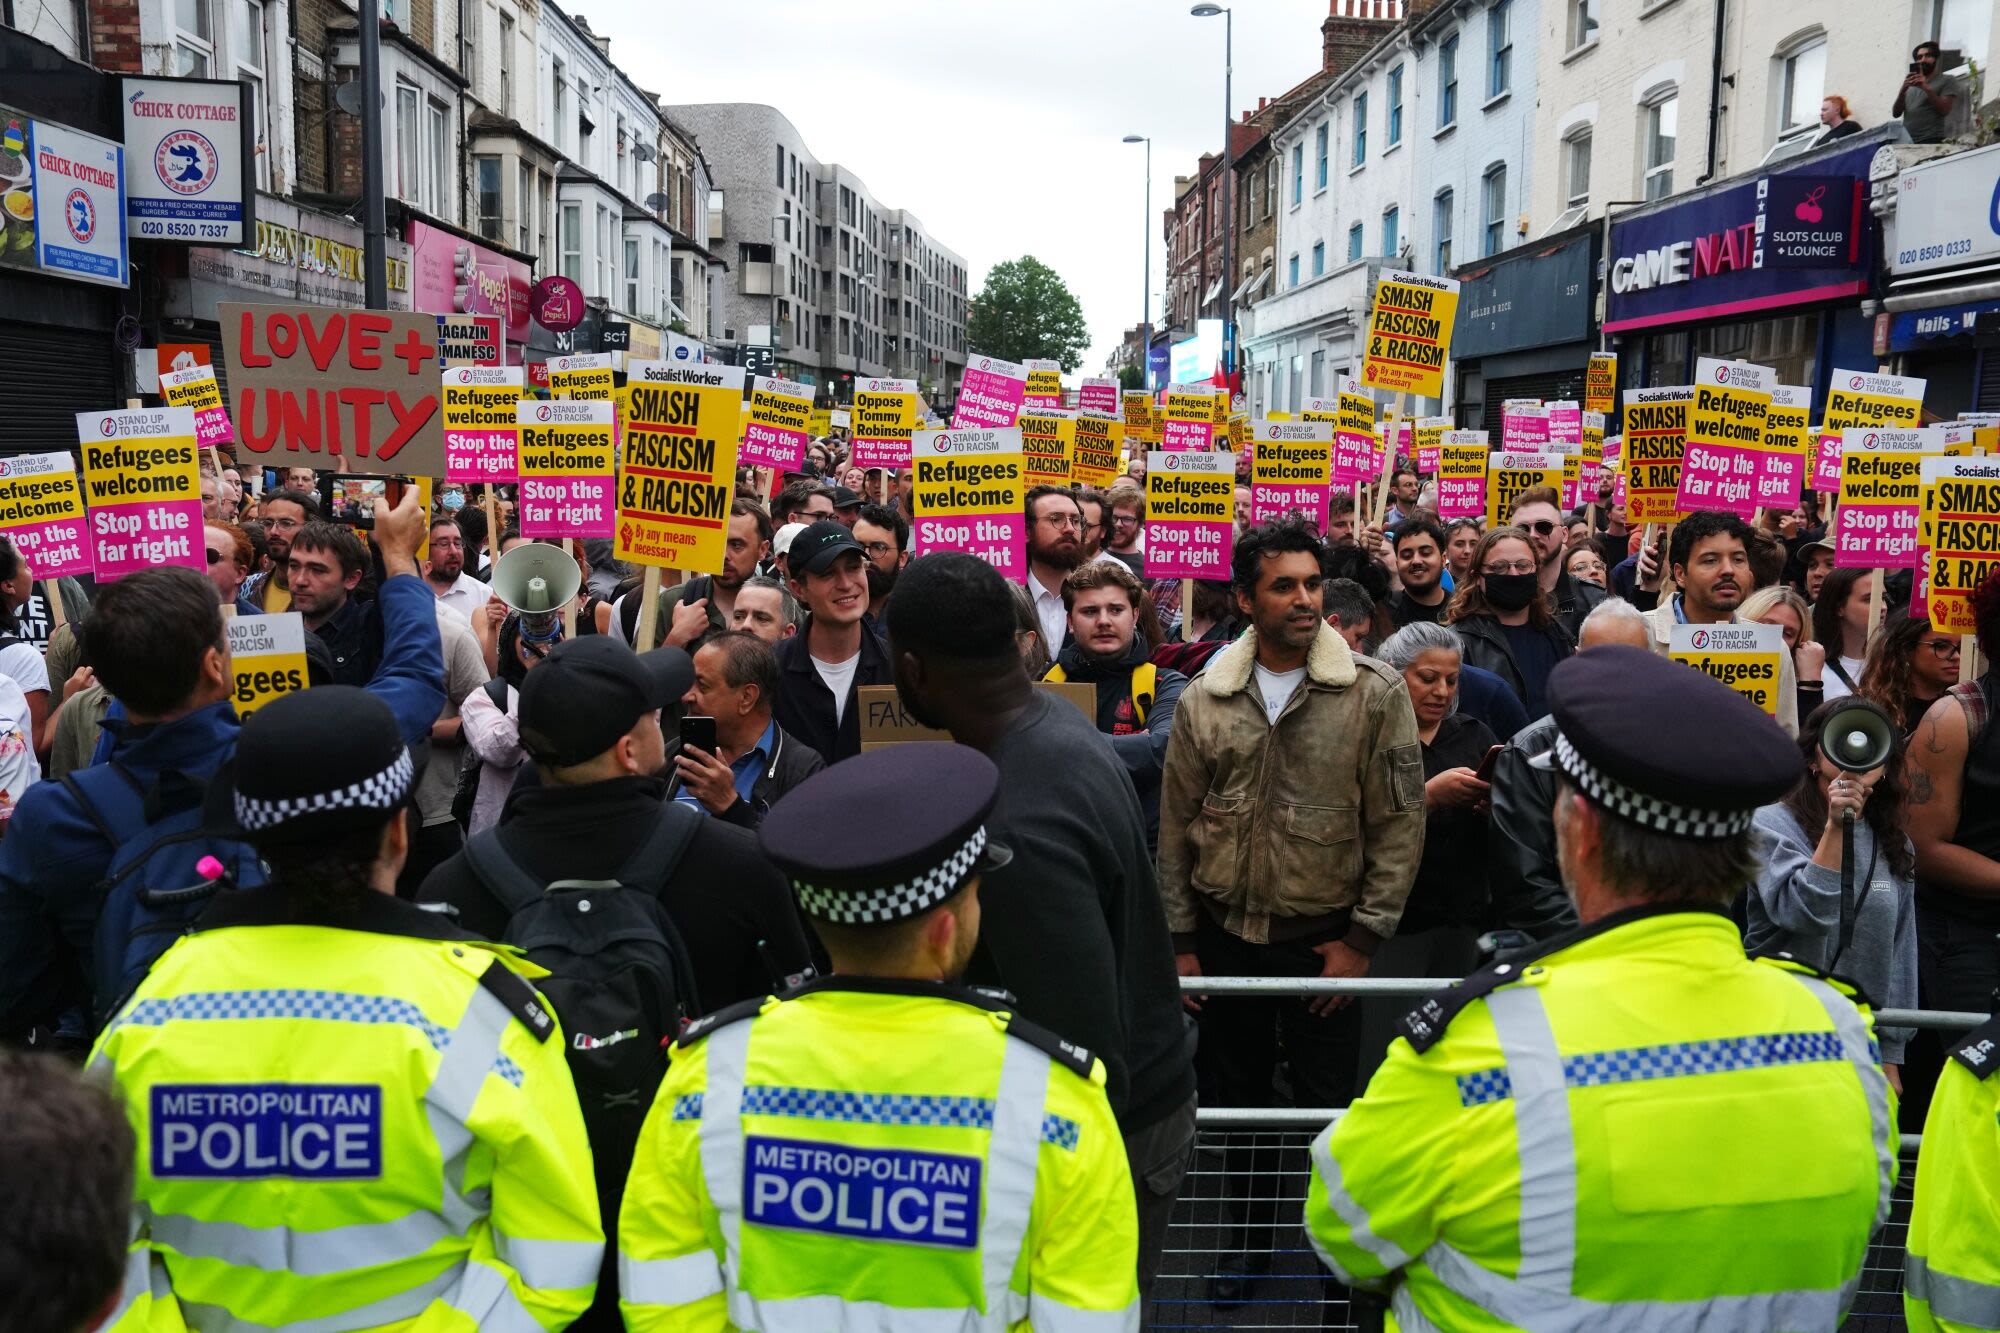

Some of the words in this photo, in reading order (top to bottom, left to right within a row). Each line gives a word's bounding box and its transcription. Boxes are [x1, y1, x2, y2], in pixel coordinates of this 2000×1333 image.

[129, 90, 144, 103] CENTRAL
[133, 101, 174, 118] CHICK
[177, 104, 236, 121] COTTAGE
[39, 152, 72, 176] CHICK
[74, 165, 115, 189] COTTAGE
[1904, 177, 1917, 191] 161
[142, 222, 163, 234] 020
[168, 223, 196, 236] 8520
[200, 225, 228, 237] 7337
[1773, 231, 1809, 242] SLOTS
[1812, 232, 1843, 242] CLUB
[1788, 247, 1836, 256] LOUNGE
[1900, 251, 1916, 265] 020
[1920, 248, 1943, 261] 8509
[1946, 239, 1971, 257] 0333
[479, 270, 507, 306] Pepe's
[1566, 284, 1578, 295] 157
[1379, 285, 1434, 311] SMASH
[1497, 301, 1512, 312] RICE
[544, 311, 567, 320] Pepe's
[1375, 311, 1441, 339] FASCISM
[1916, 317, 1951, 333] Nails
[240, 311, 392, 371] LOVE
[968, 371, 981, 380] Say
[991, 375, 1007, 386] loud
[1380, 366, 1388, 376] By
[1389, 368, 1402, 378] any
[1404, 372, 1424, 381] means
[965, 379, 979, 388] Say
[988, 387, 1010, 396] clear:
[1731, 377, 1740, 385] TO
[1741, 379, 1761, 389] RACISM
[629, 387, 700, 426] SMASH
[857, 394, 903, 409] Oppose
[1169, 396, 1212, 409] Refugees
[1698, 390, 1767, 419] Refugees
[1831, 395, 1915, 419] Refugees
[118, 416, 148, 426] STAND
[151, 415, 164, 423] UP
[448, 411, 516, 424] welcome
[565, 414, 593, 422] RACISM
[858, 409, 901, 424] Tommy
[1168, 409, 1209, 419] welcome
[119, 426, 132, 435] TO
[134, 423, 170, 434] RACISM
[239, 387, 439, 462] UNITY
[857, 424, 912, 437] Robinson
[1166, 422, 1188, 434] Stop
[1191, 424, 1206, 434] the
[1695, 417, 1760, 442] welcome
[448, 434, 485, 454] Stop
[489, 434, 515, 450] the
[523, 429, 609, 450] Refugees
[953, 433, 980, 443] STAND
[982, 432, 995, 442] UP
[1166, 434, 1180, 444] far
[1182, 435, 1204, 446] right
[1506, 430, 1545, 441] Refugees
[626, 431, 715, 473] FASCISM
[856, 440, 876, 451] Stop
[877, 440, 908, 450] fascists
[953, 443, 965, 452] TO
[967, 442, 999, 451] RACISM
[1257, 444, 1327, 463] Refugees
[88, 446, 192, 471] Refugees
[448, 454, 472, 469] far
[477, 454, 515, 473] right
[524, 451, 605, 469] welcome
[1689, 448, 1730, 476] Stop
[1733, 454, 1754, 475] the
[918, 461, 1018, 485] Refugees
[1257, 463, 1323, 478] welcome
[1442, 462, 1482, 473] welcome
[91, 473, 189, 497] welcome
[1151, 476, 1231, 497] Refugees
[1441, 481, 1464, 494] Stop
[1466, 481, 1479, 492] the
[1498, 472, 1544, 487] STOP
[1685, 473, 1712, 495] far
[1716, 478, 1751, 502] right
[525, 481, 567, 503] Stop
[571, 481, 603, 498] the
[920, 487, 1014, 508] welcome
[1256, 488, 1290, 505] Stop
[1295, 488, 1320, 504] the
[1151, 498, 1225, 515] welcome
[1441, 495, 1455, 506] far
[1458, 495, 1478, 508] right
[95, 512, 142, 537] Stop
[147, 507, 189, 530] the
[525, 503, 553, 521] far
[558, 503, 602, 525] right
[920, 522, 970, 547] Stop
[976, 520, 1012, 541] the
[1149, 525, 1189, 546] Stop
[1194, 526, 1221, 544] the
[1149, 547, 1174, 564] far
[1180, 547, 1220, 568] right
[1712, 631, 1740, 639] STAND
[1742, 631, 1753, 639] UP
[1712, 641, 1722, 649] TO
[1726, 641, 1757, 649] RACISM
[162, 1093, 371, 1116] METROPOLITAN
[162, 1121, 371, 1170] POLICE
[755, 1145, 970, 1187] METROPOLITAN
[753, 1173, 968, 1238] POLICE
